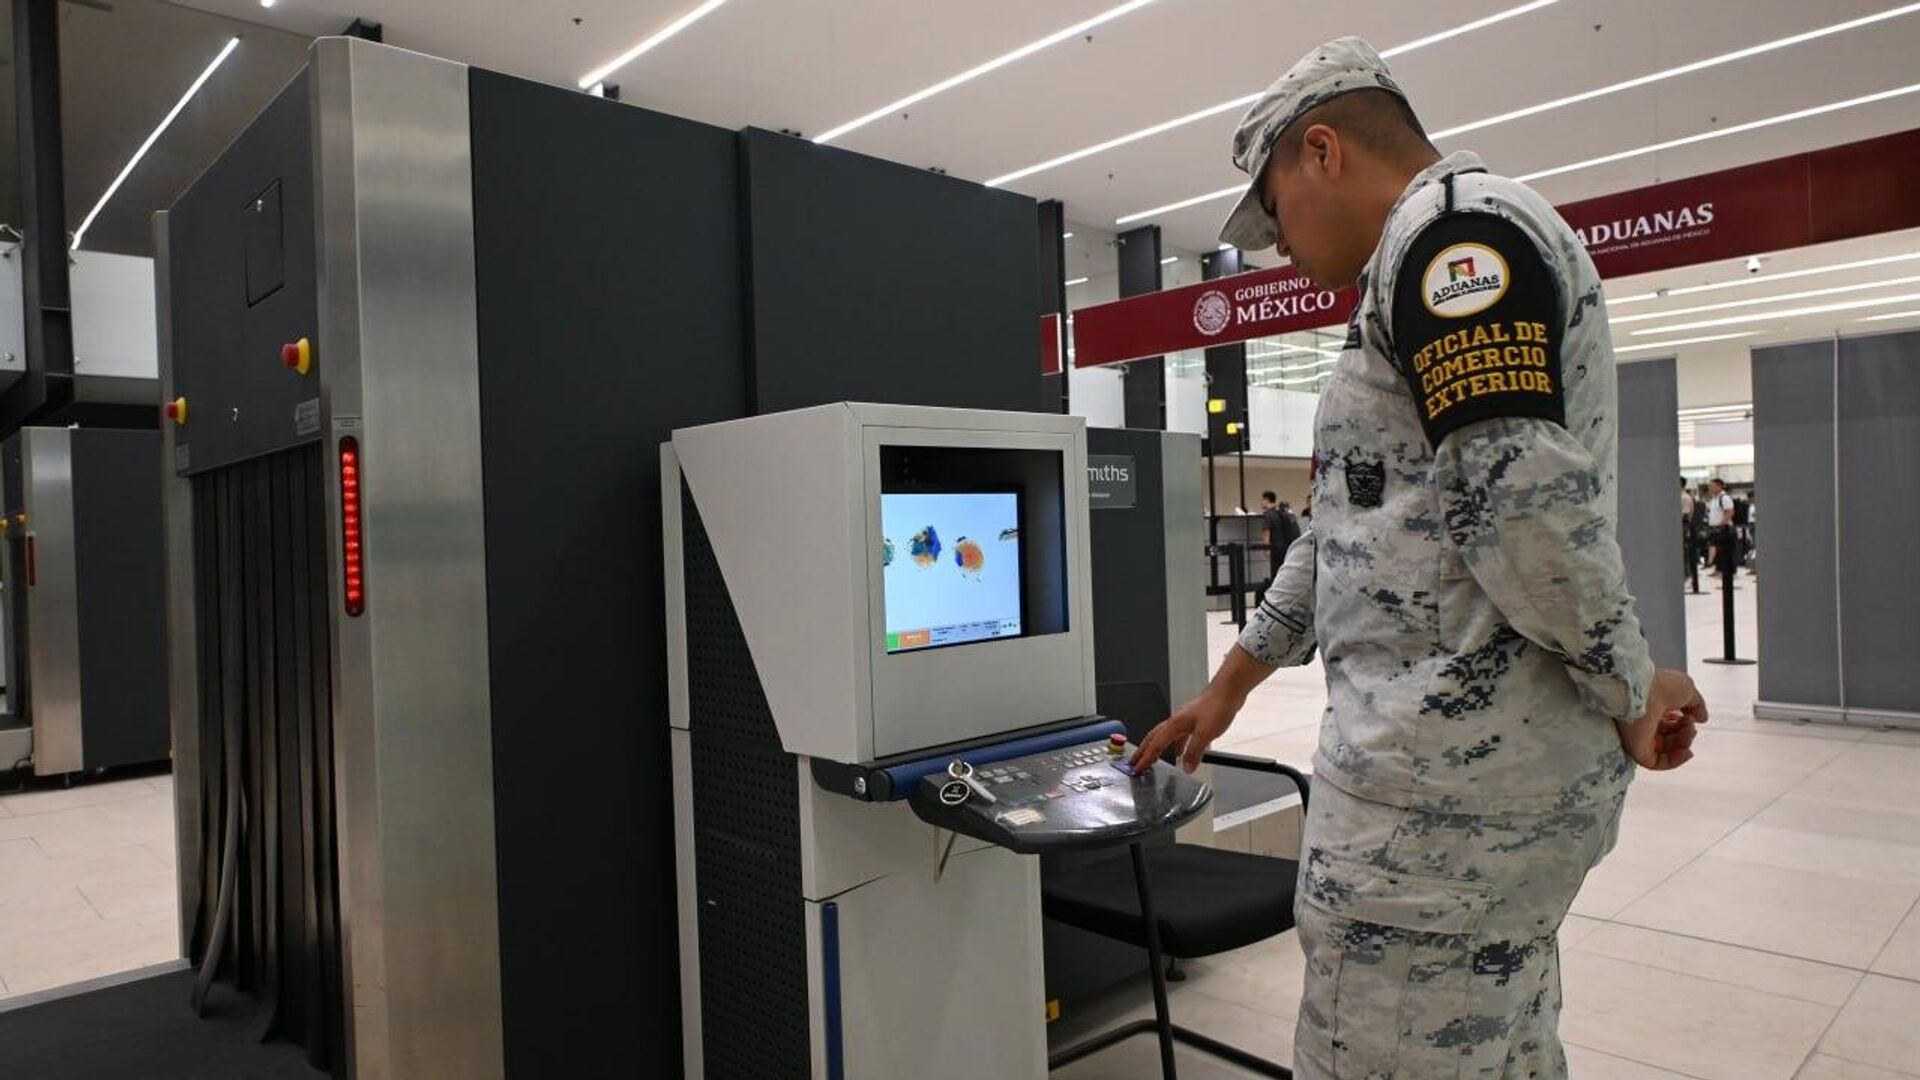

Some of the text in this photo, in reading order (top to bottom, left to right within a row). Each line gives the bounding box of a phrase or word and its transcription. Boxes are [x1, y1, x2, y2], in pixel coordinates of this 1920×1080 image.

[1576, 202, 1715, 247] ADUANAS
[1235, 277, 1310, 301] GOBIERNO
[1236, 290, 1335, 324] MÉXICO
[1432, 274, 1500, 301] ADUANAS
[1413, 321, 1549, 373] OFICIAL DE
[1422, 346, 1547, 394] COMERCIO
[1425, 370, 1553, 421] EXTERIOR
